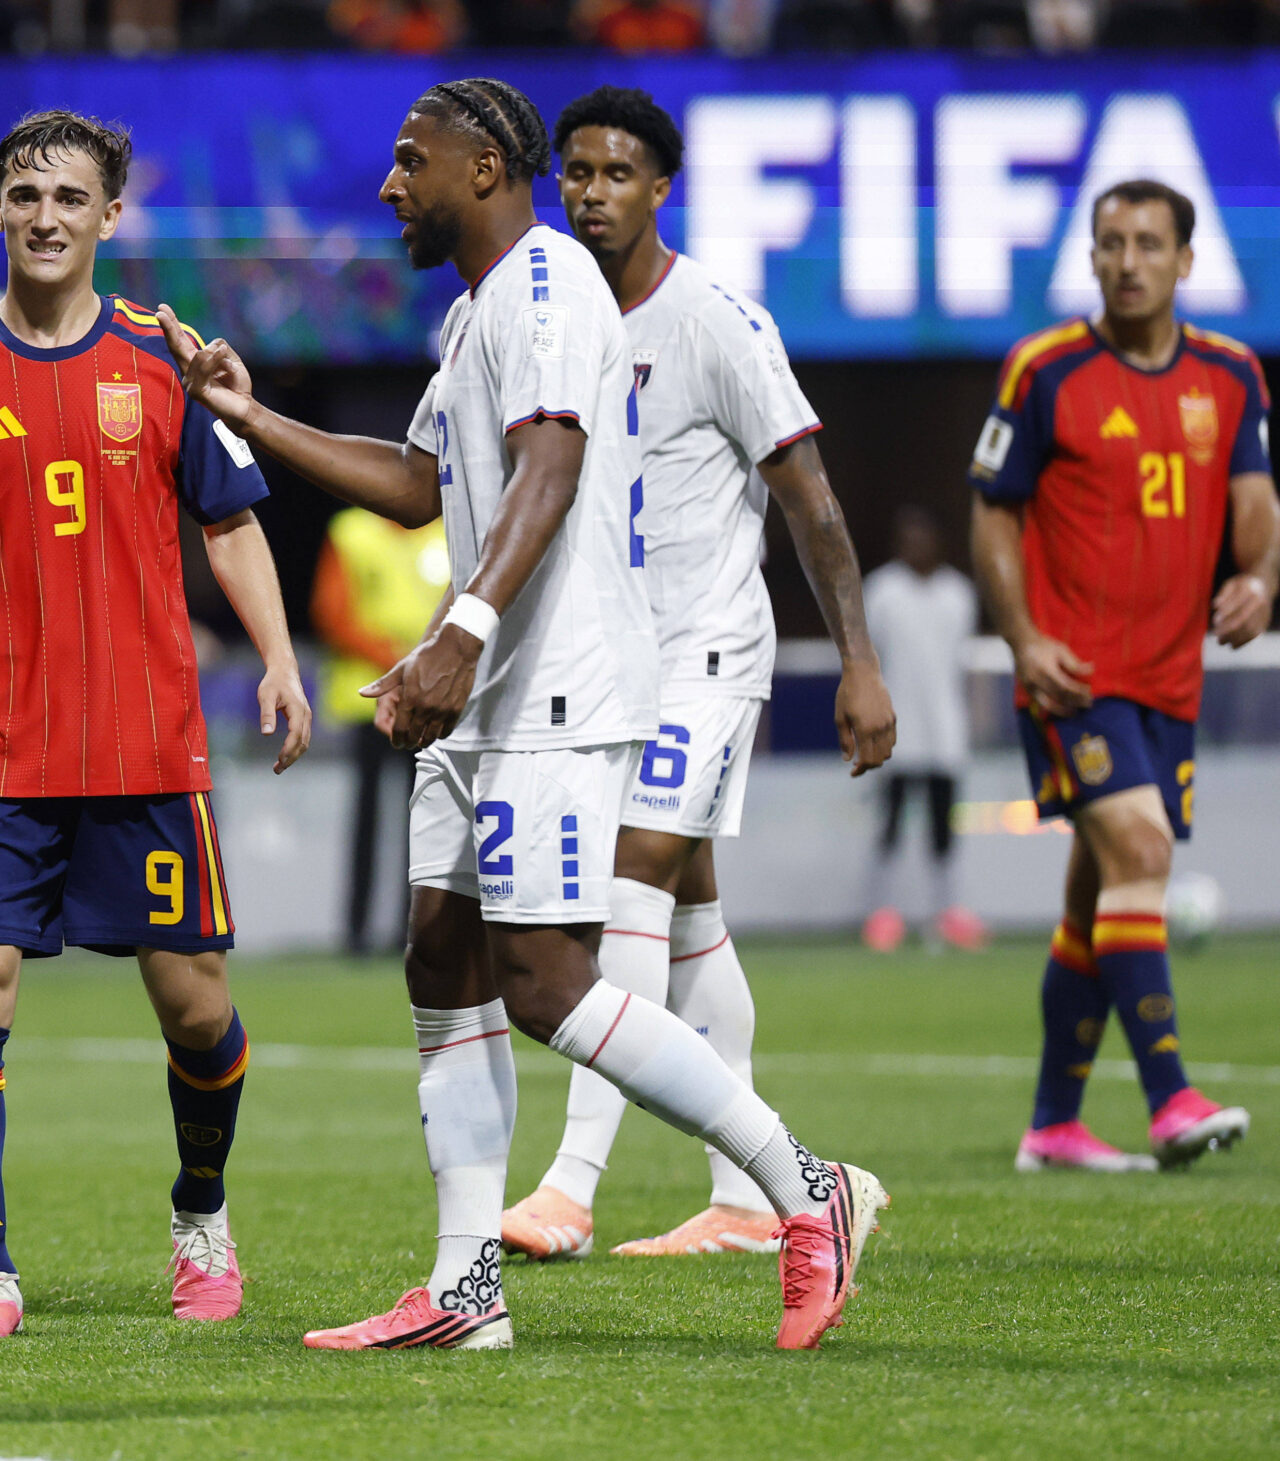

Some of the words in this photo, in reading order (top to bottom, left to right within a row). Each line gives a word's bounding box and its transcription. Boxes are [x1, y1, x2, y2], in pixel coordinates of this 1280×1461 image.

[686, 95, 1247, 317] FIFA
[45, 460, 86, 536] 9
[1139, 452, 1186, 518] 21
[639, 725, 690, 788] 6
[632, 793, 680, 809] capelli
[475, 801, 514, 876] 2
[146, 850, 184, 924] 9
[479, 880, 514, 898] apelli
